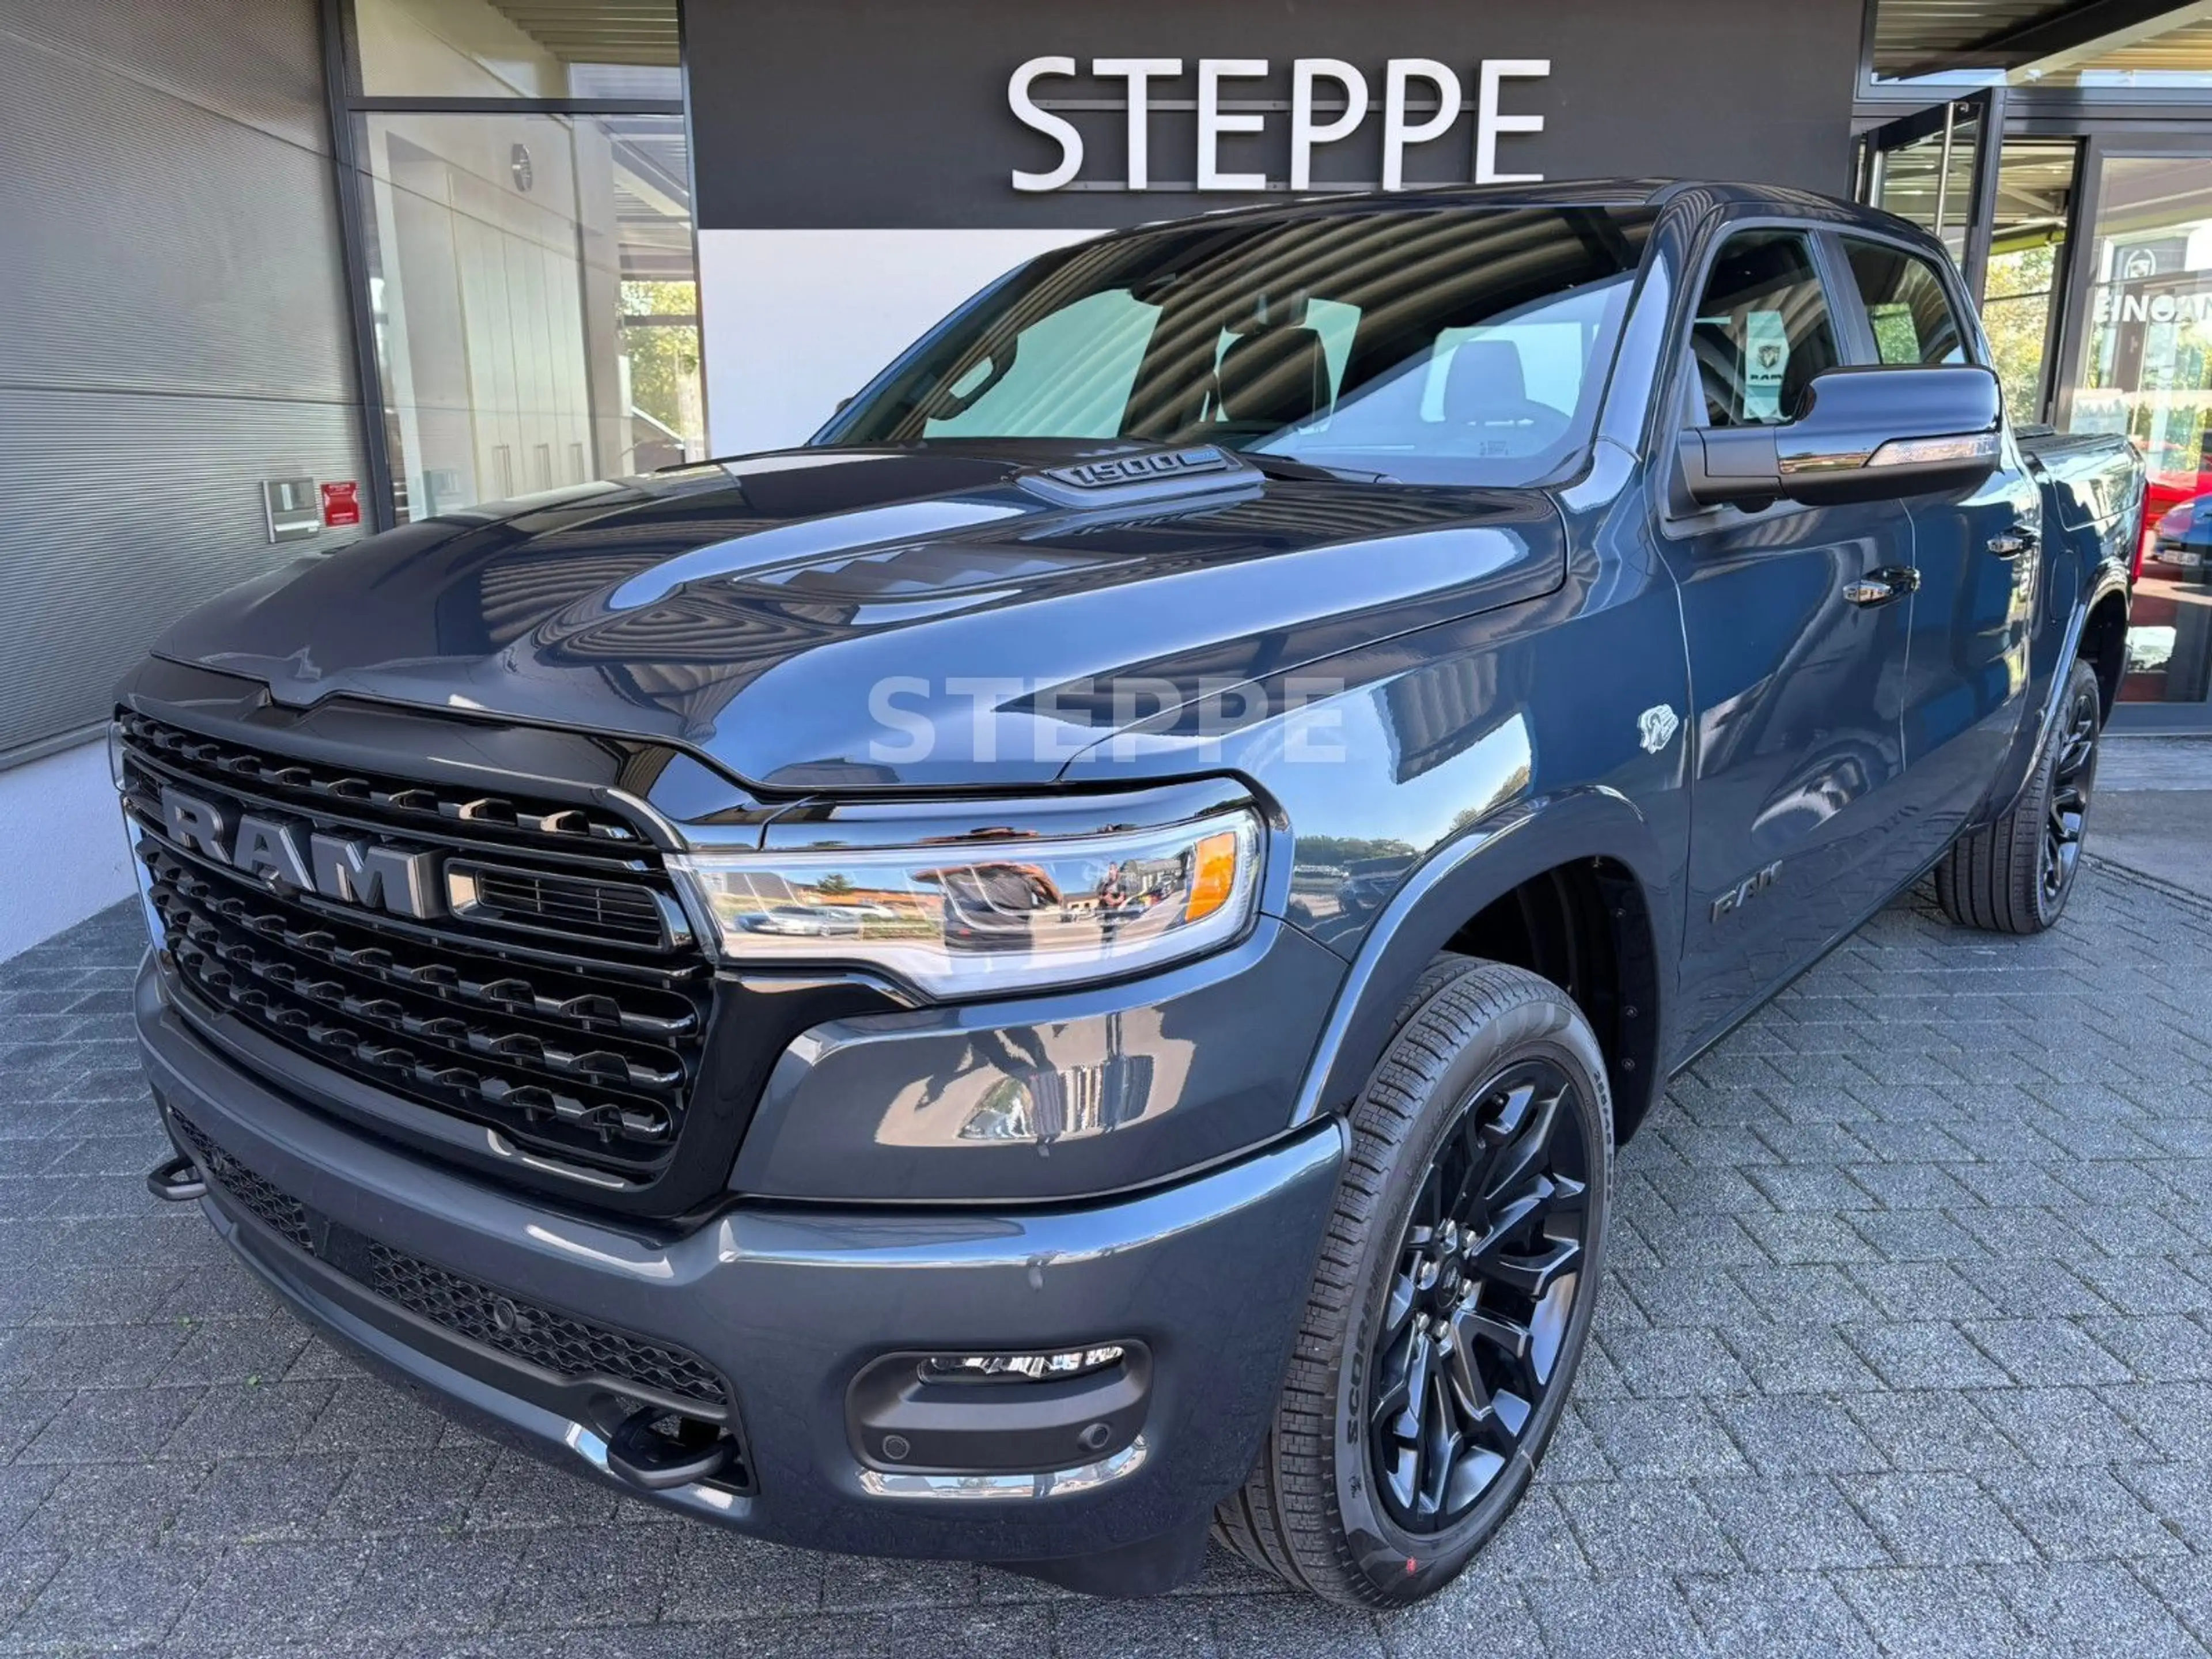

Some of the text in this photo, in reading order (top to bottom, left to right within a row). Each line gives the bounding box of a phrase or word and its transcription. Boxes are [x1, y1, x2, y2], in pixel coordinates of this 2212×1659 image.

[1007, 55, 1551, 191] STEPPE
[1070, 453, 1180, 485] 1500
[162, 785, 435, 920] RAM
